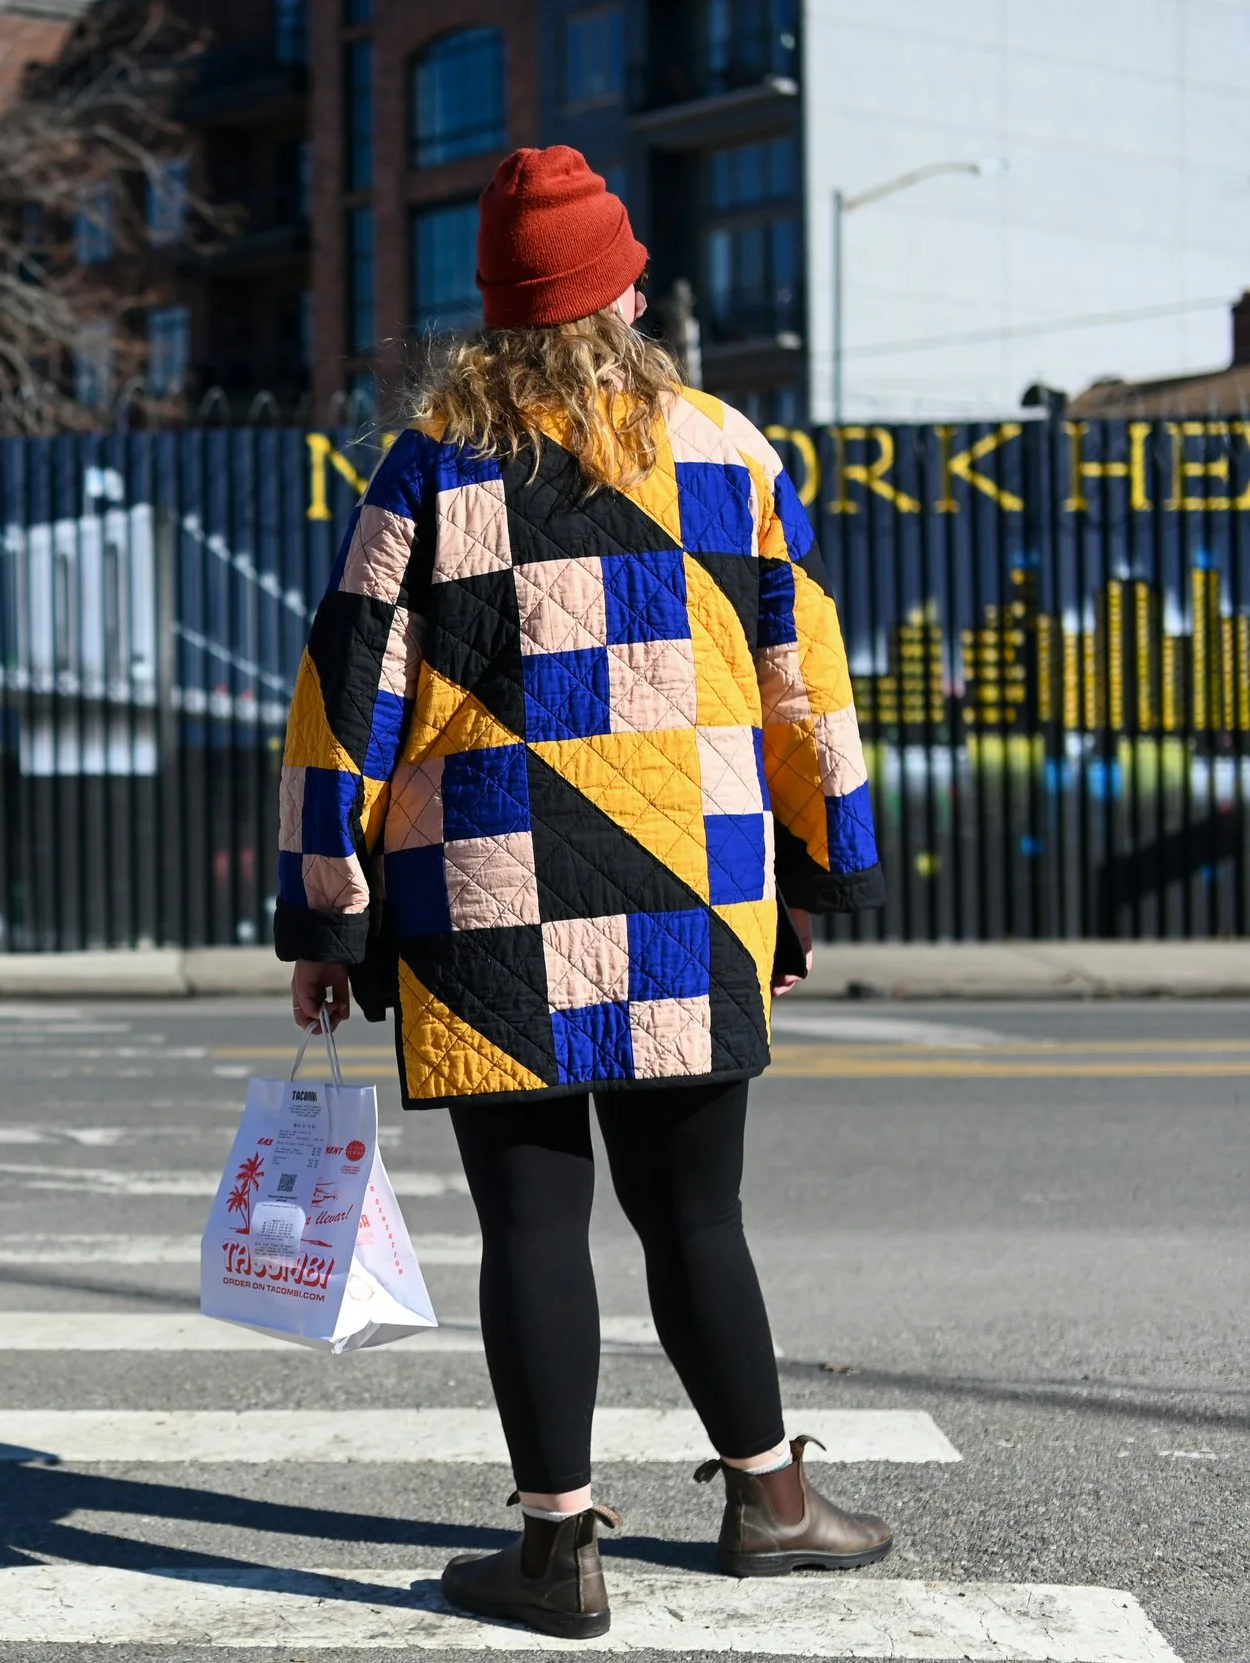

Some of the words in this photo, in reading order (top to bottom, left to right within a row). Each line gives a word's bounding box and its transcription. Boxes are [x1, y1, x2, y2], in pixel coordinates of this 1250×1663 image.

[764, 423, 1024, 514] ORK
[257, 1137, 275, 1146] EAS
[316, 1204, 354, 1225] llevar!
[222, 1277, 251, 1289] ORDER
[252, 1282, 265, 1291] ON
[266, 1285, 326, 1302] TACOMBI.COM
